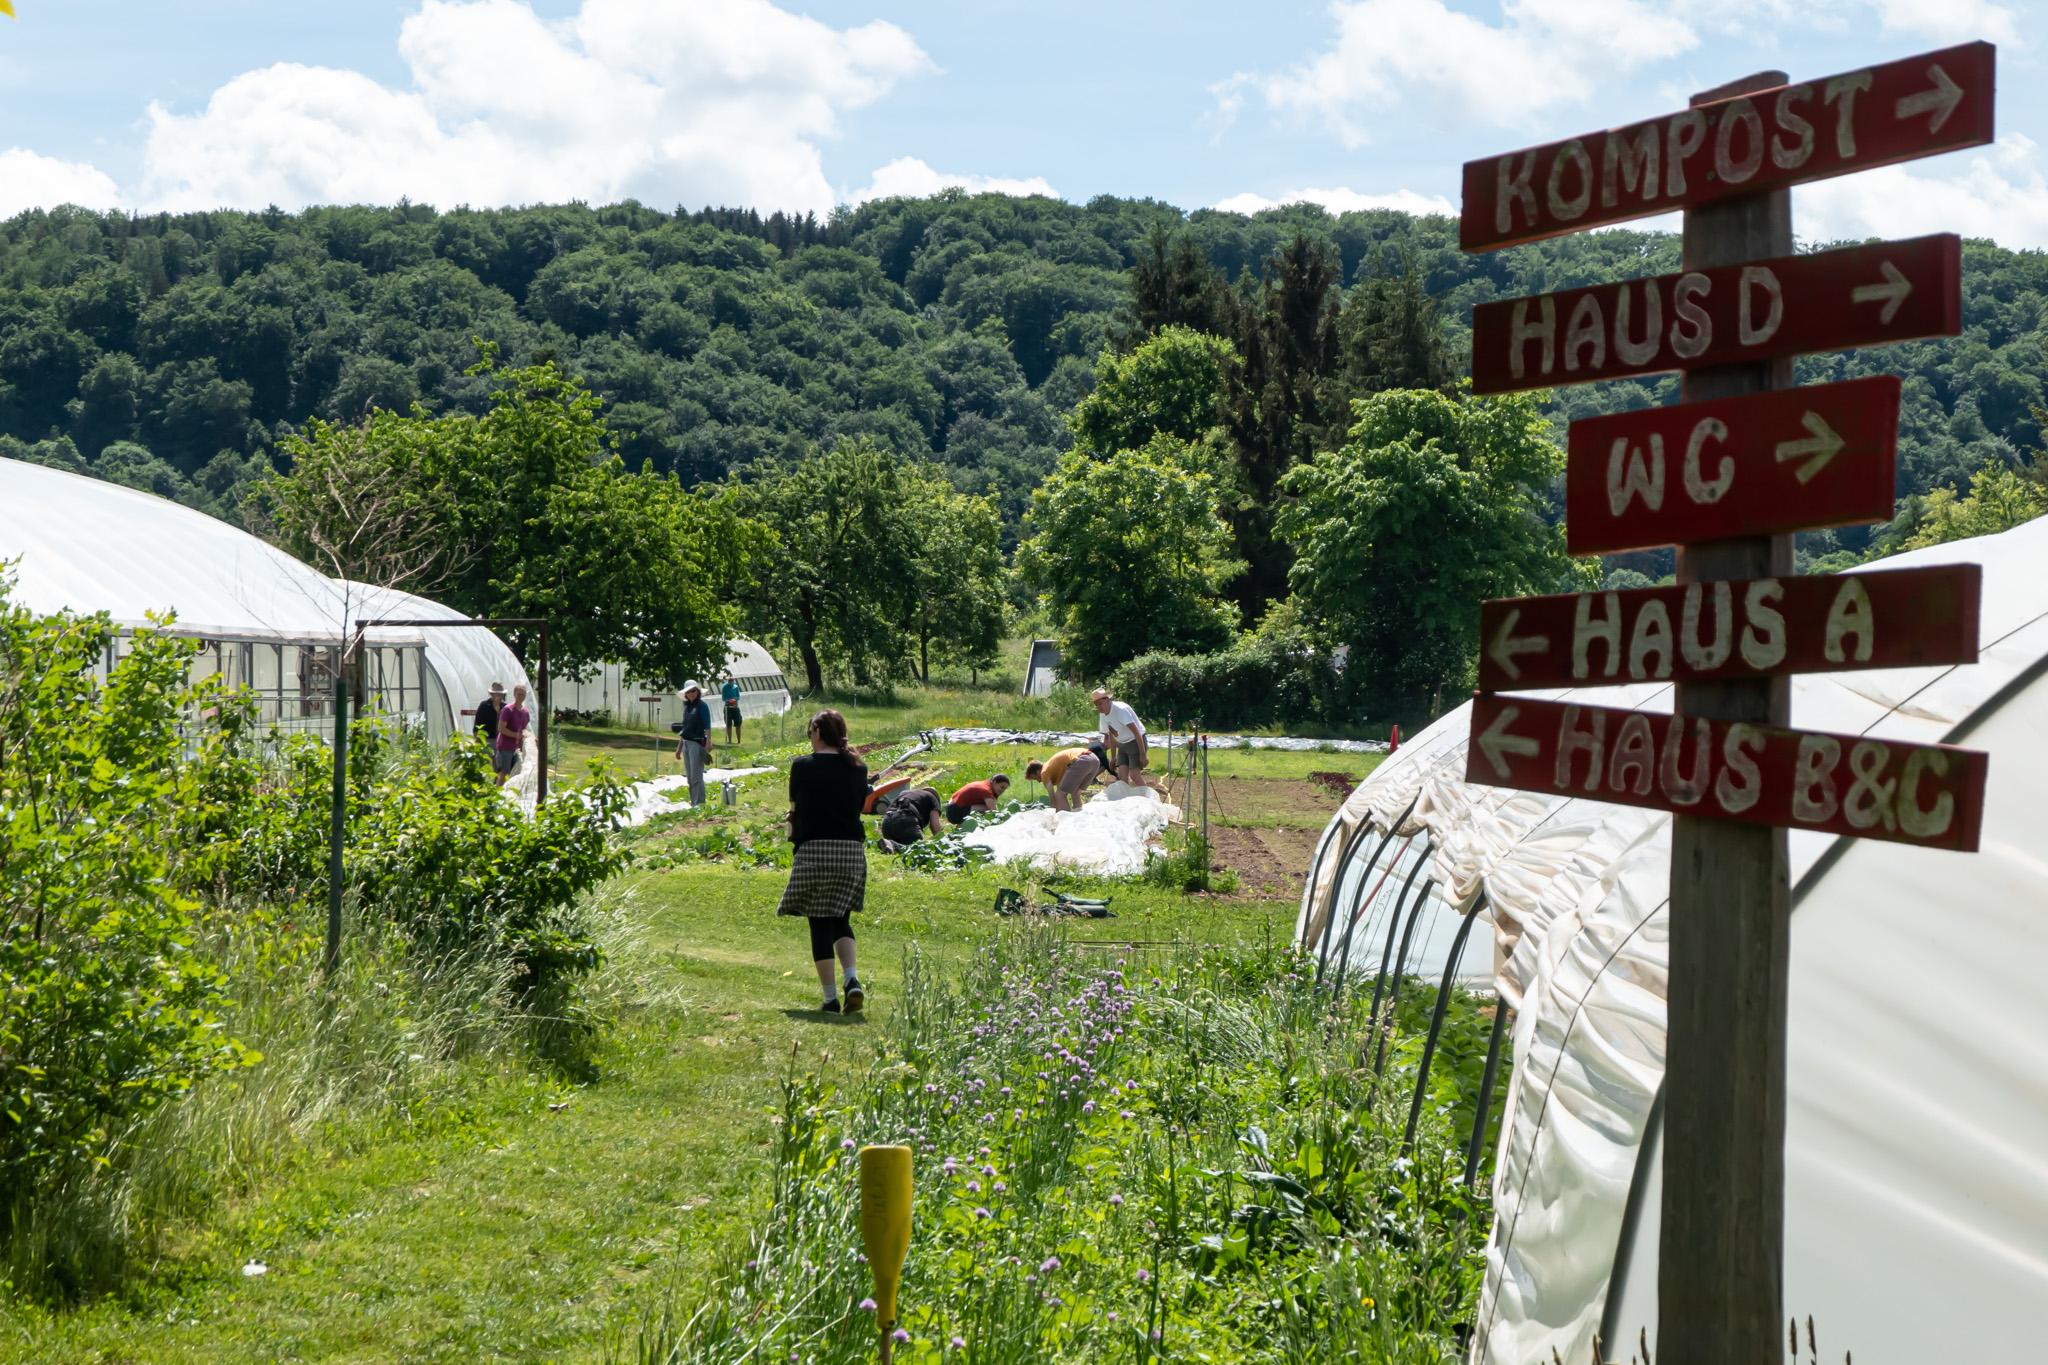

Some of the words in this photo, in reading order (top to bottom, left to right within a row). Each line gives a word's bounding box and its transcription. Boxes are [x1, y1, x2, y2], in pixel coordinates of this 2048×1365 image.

[1496, 68, 1873, 233] KOMPOST
[1509, 272, 1712, 380] HAUS
[1739, 266, 1784, 346] D
[1607, 417, 1735, 517] WC
[1572, 578, 1787, 679] HAUS
[1824, 576, 1874, 662] A
[1554, 705, 1764, 813] HAUS
[1792, 734, 1954, 837] B&C
